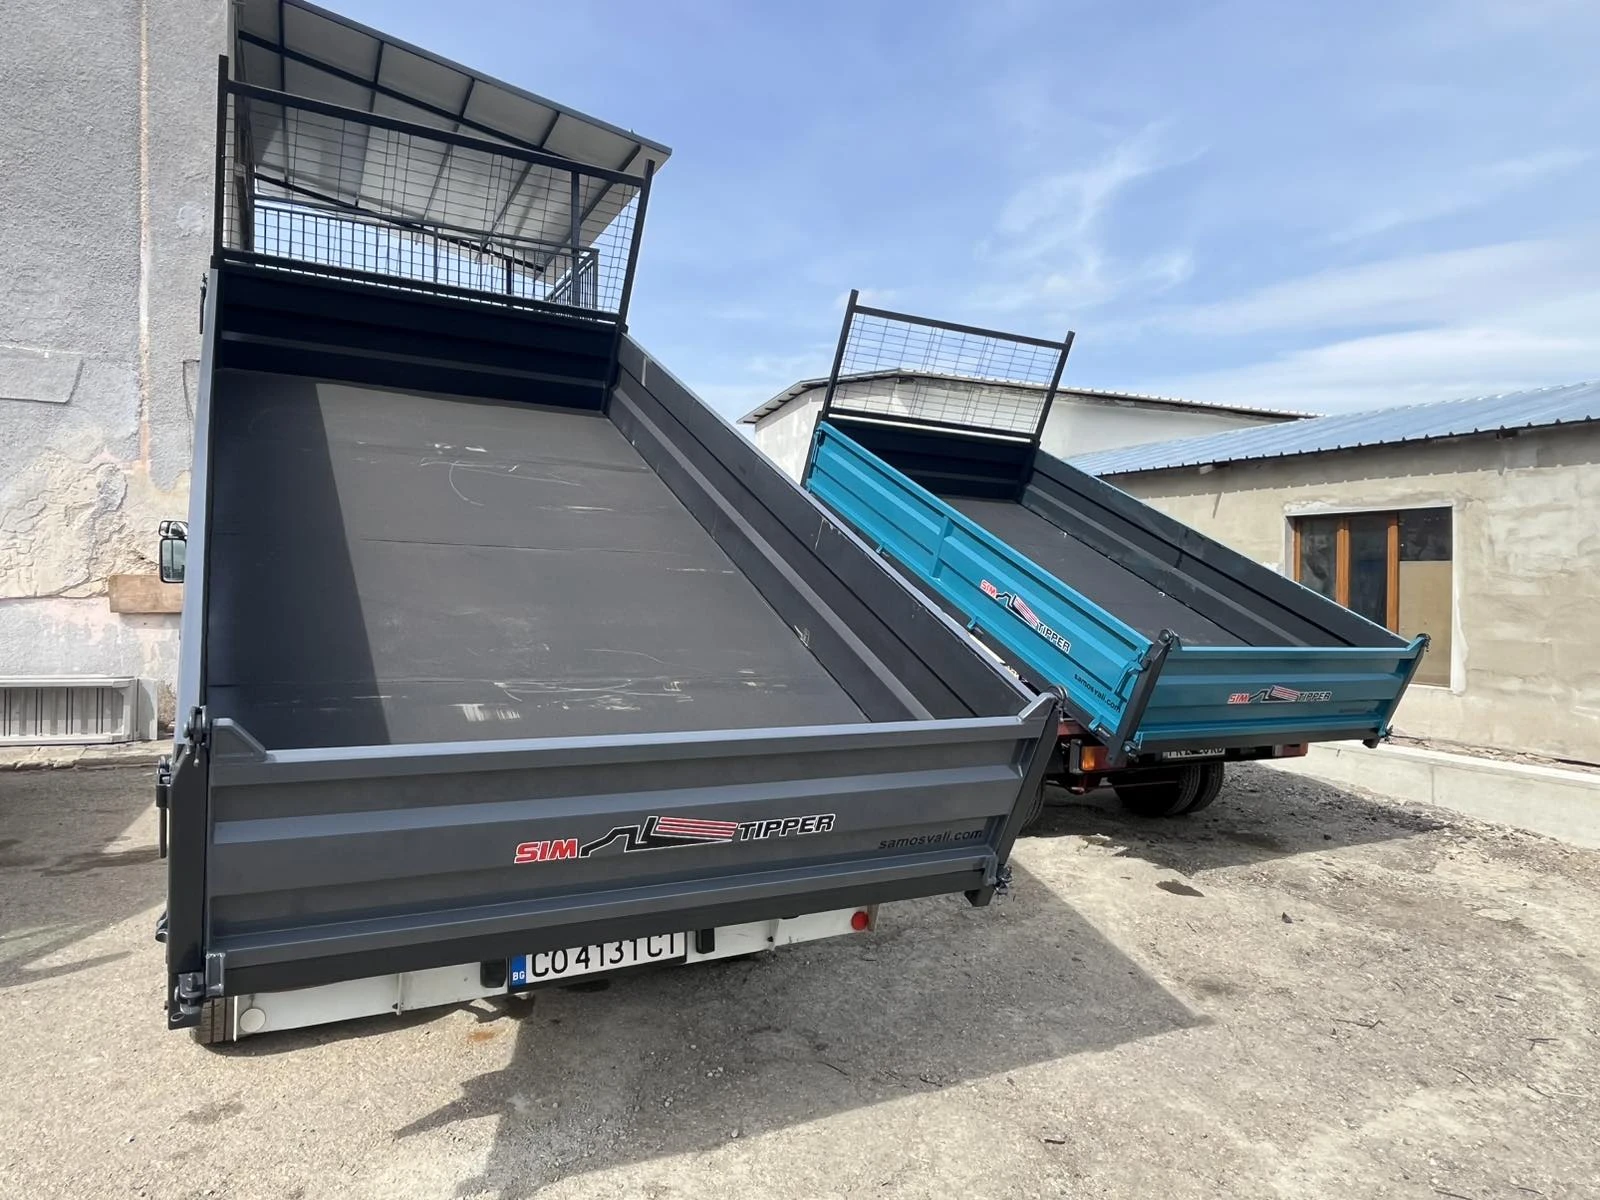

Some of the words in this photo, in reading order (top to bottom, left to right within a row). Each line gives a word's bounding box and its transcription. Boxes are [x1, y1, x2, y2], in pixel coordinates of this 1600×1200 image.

[980, 579, 998, 600] SIM
[1037, 622, 1071, 654] TIPPER
[1074, 673, 1121, 713] samosvali.com
[1227, 693, 1250, 704] SIM
[1298, 691, 1332, 702] TIPPER
[514, 839, 578, 863] SIM
[739, 814, 836, 840] TIPPER
[878, 829, 983, 849] samosvali.com
[512, 971, 526, 981] BG
